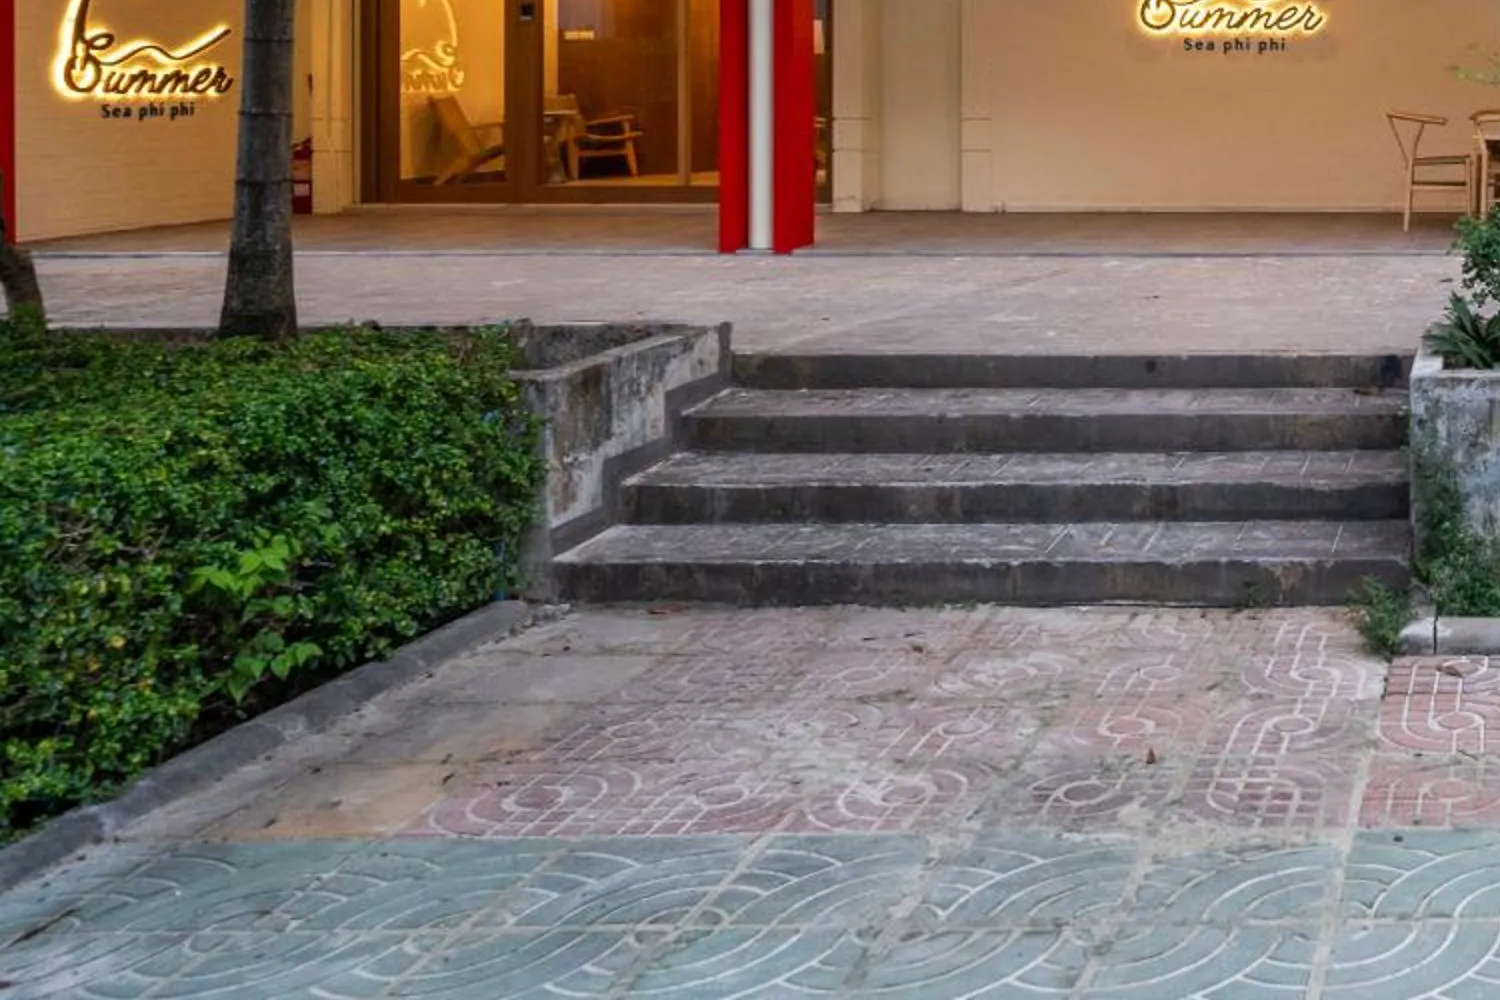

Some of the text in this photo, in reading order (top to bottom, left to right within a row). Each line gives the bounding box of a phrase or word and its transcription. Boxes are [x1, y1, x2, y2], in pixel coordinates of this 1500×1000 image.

[1183, 37, 1286, 55] Sea phi phi
[64, 33, 234, 93] Summer
[101, 101, 195, 121] Sea phi phi
